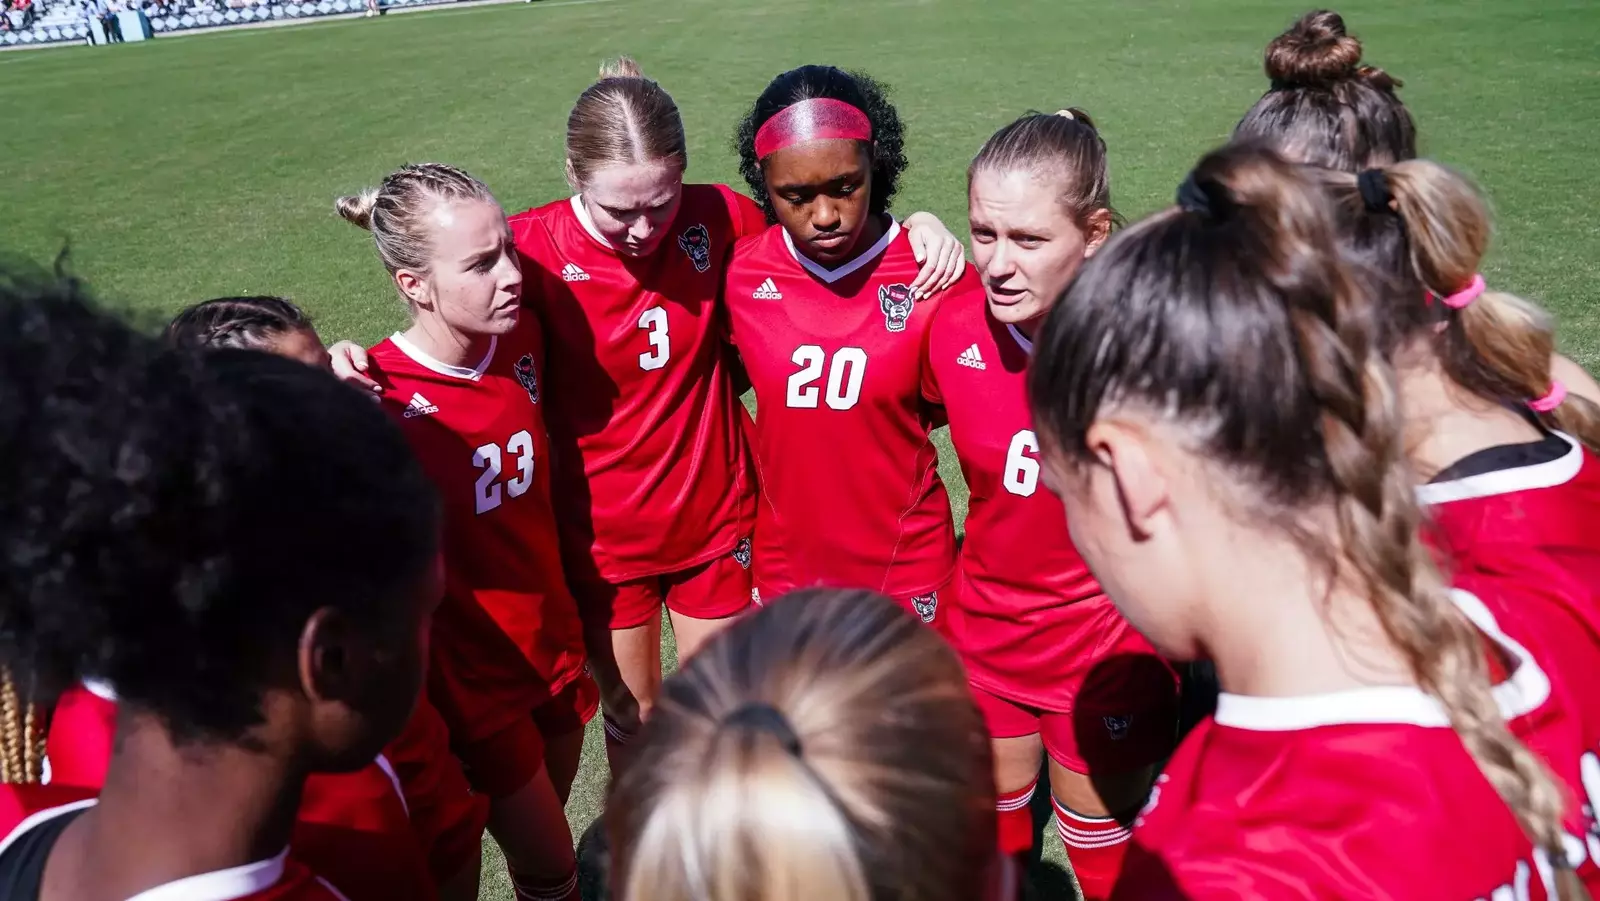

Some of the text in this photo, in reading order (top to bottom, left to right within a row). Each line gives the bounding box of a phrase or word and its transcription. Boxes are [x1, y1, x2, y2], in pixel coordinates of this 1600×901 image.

[562, 273, 591, 282] didas
[752, 291, 783, 300] adidas
[638, 306, 671, 371] 3
[786, 344, 868, 411] 20
[956, 357, 987, 371] adidas
[403, 404, 439, 419] adidas
[472, 429, 535, 515] 23
[1003, 428, 1040, 498] 6
